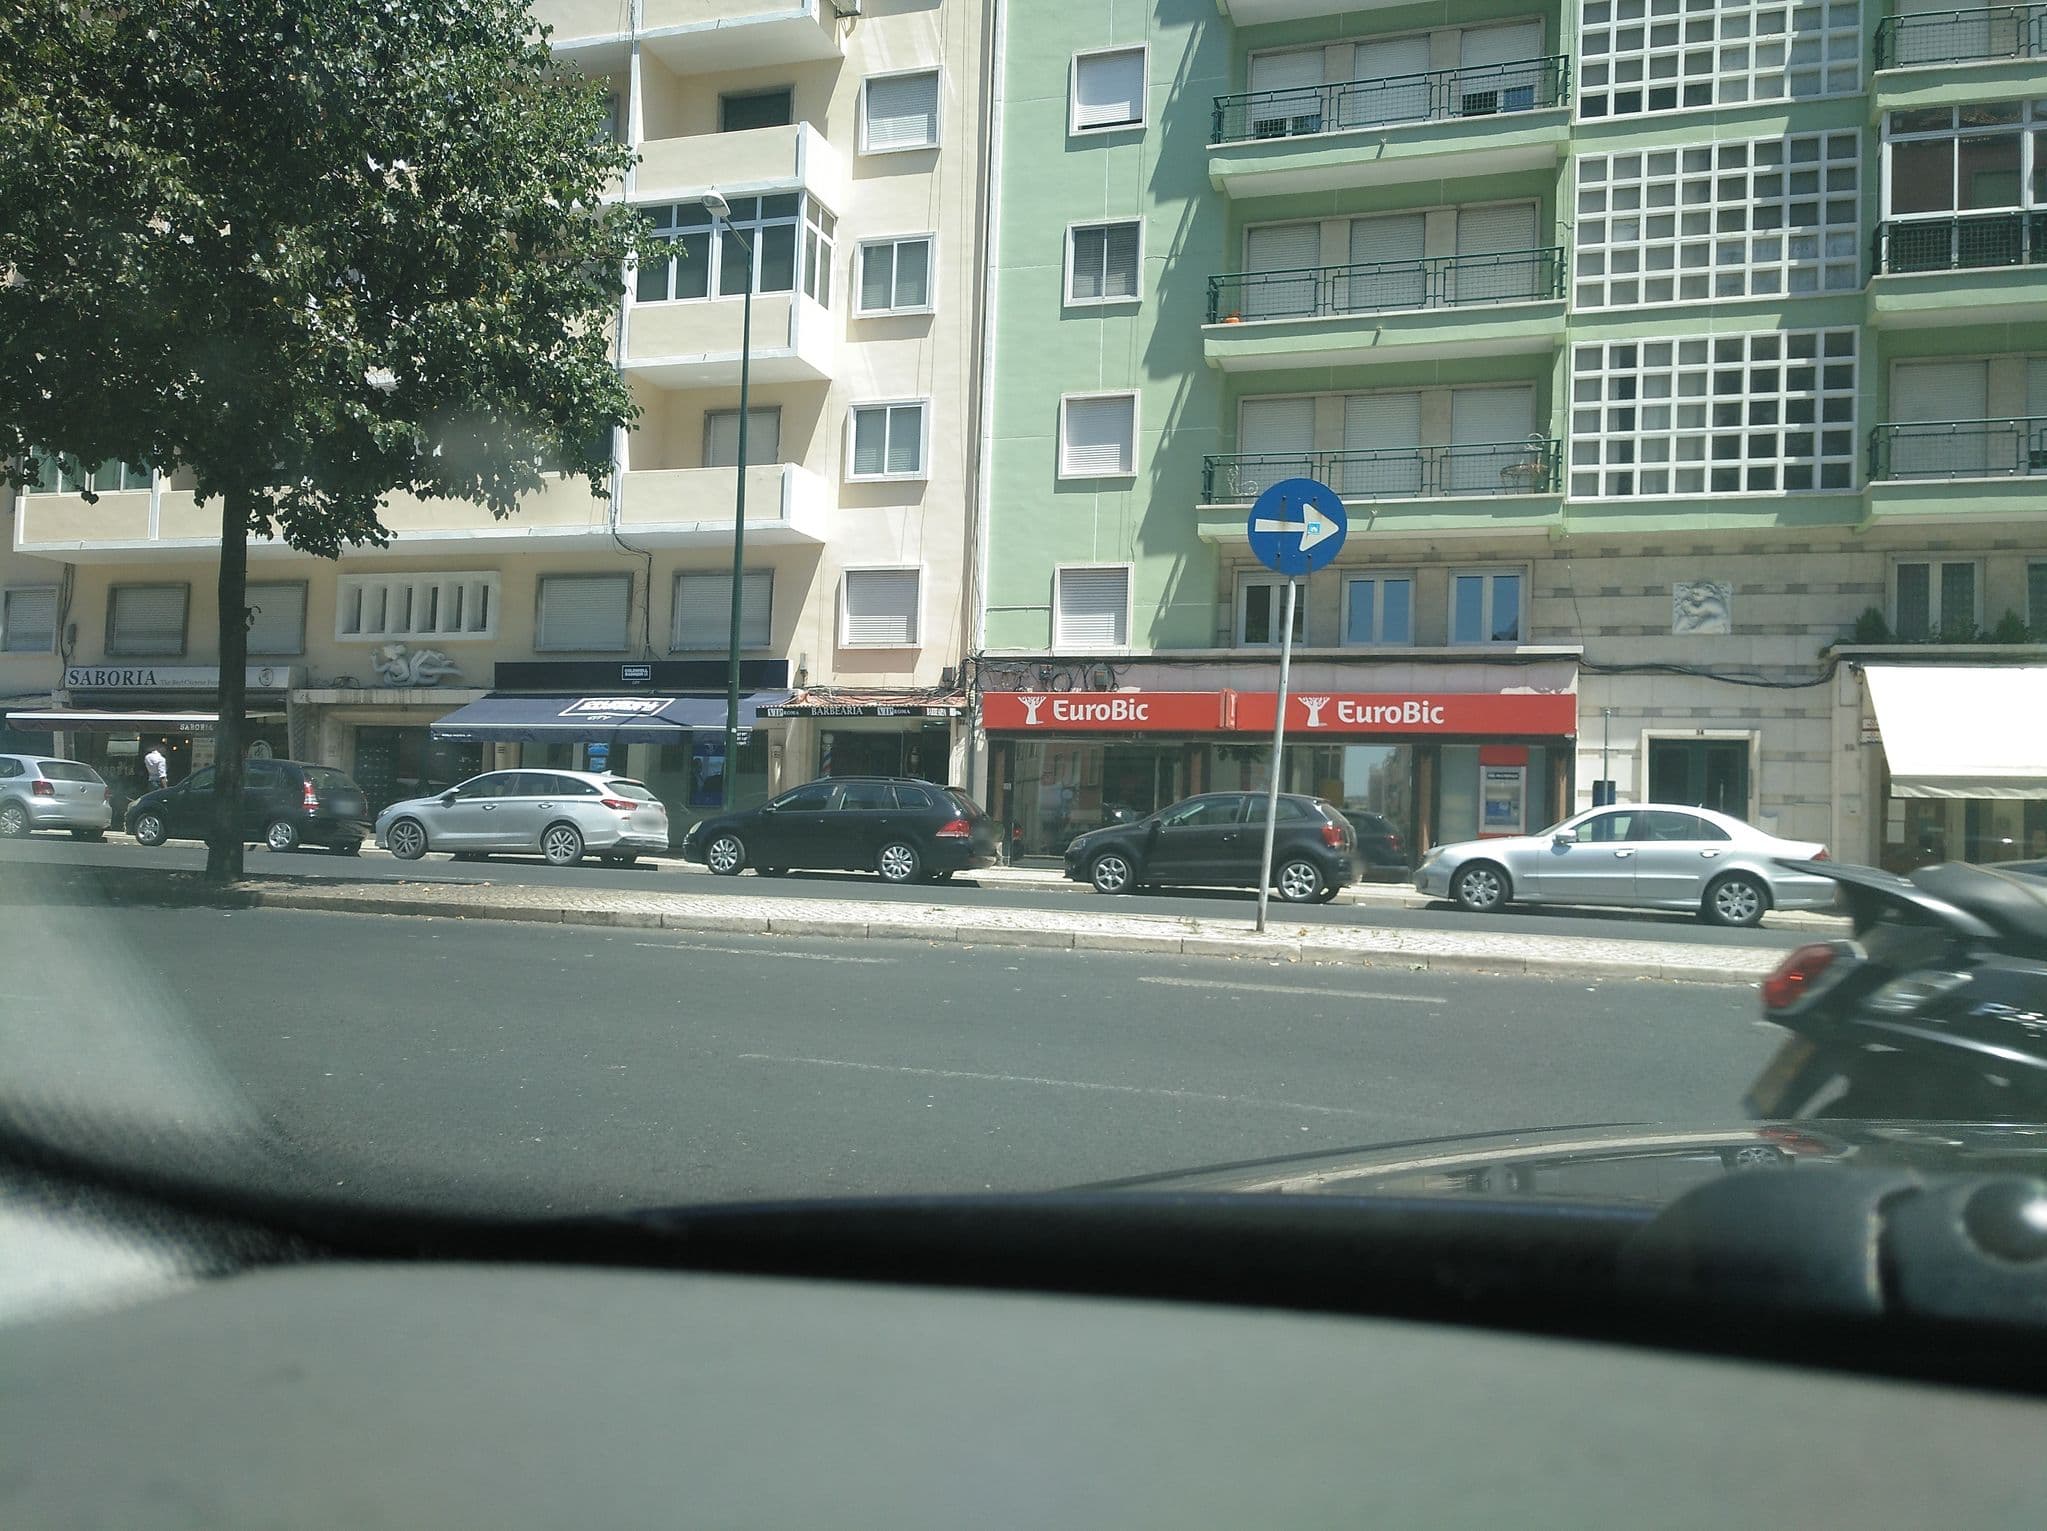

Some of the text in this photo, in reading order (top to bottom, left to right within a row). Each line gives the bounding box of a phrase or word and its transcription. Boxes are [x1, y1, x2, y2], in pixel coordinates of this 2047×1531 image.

[68, 669, 157, 687] SABORIA
[767, 708, 784, 717] VIP
[811, 706, 863, 716] BARBEARIA
[877, 707, 894, 716] VIP
[1053, 698, 1149, 721] EuroBic
[1338, 700, 1445, 724] EuroBic
